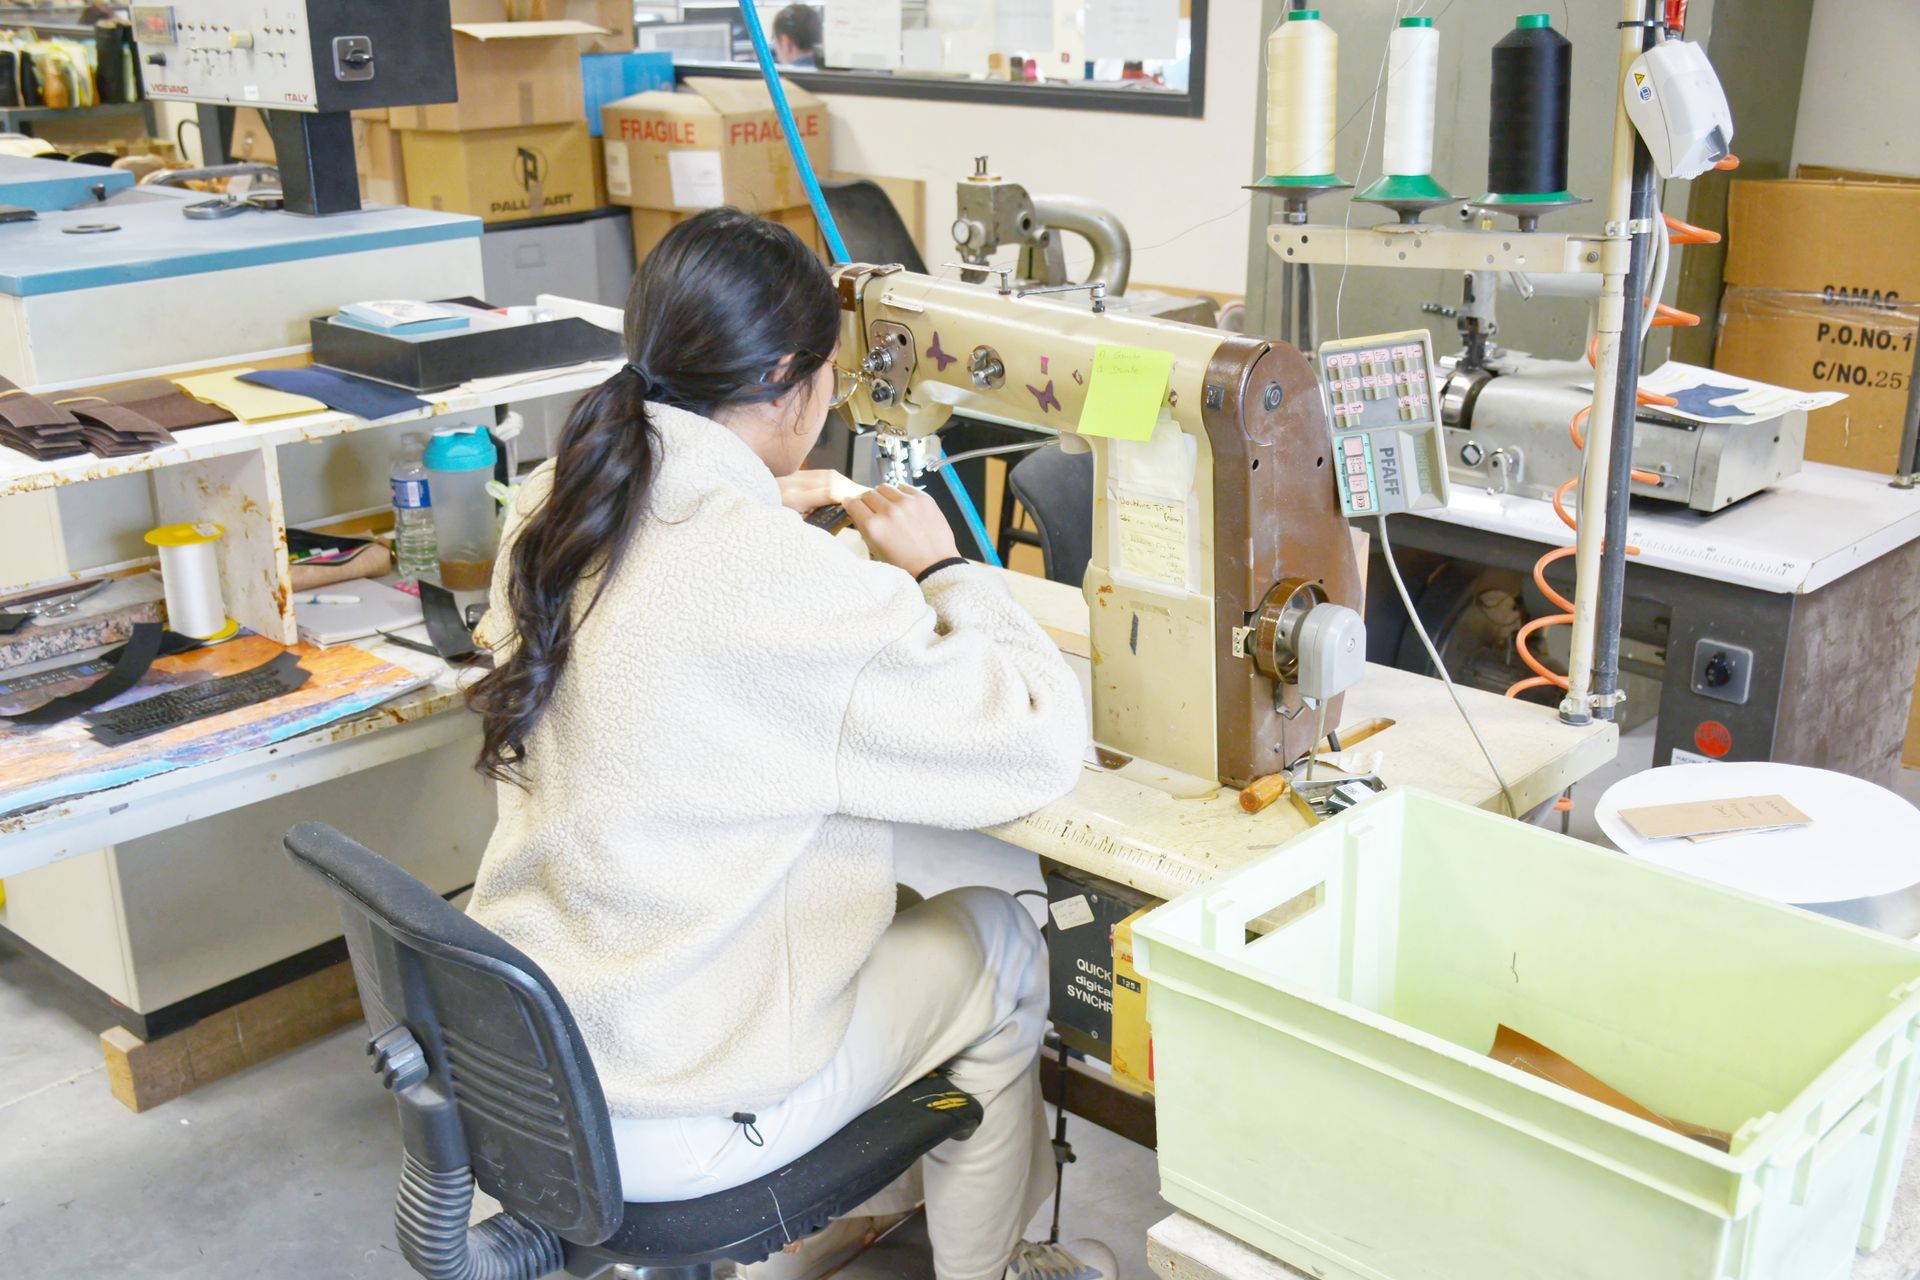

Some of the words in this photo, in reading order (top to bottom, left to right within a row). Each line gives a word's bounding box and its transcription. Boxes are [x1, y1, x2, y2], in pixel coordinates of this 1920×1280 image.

[284, 93, 309, 103] ITALY
[619, 118, 697, 145] FRAGILE
[729, 114, 819, 146] FRAGLE
[490, 193, 574, 213] PALLART
[1379, 447, 1401, 497] PFAFF
[1076, 958, 1112, 983] QUICK
